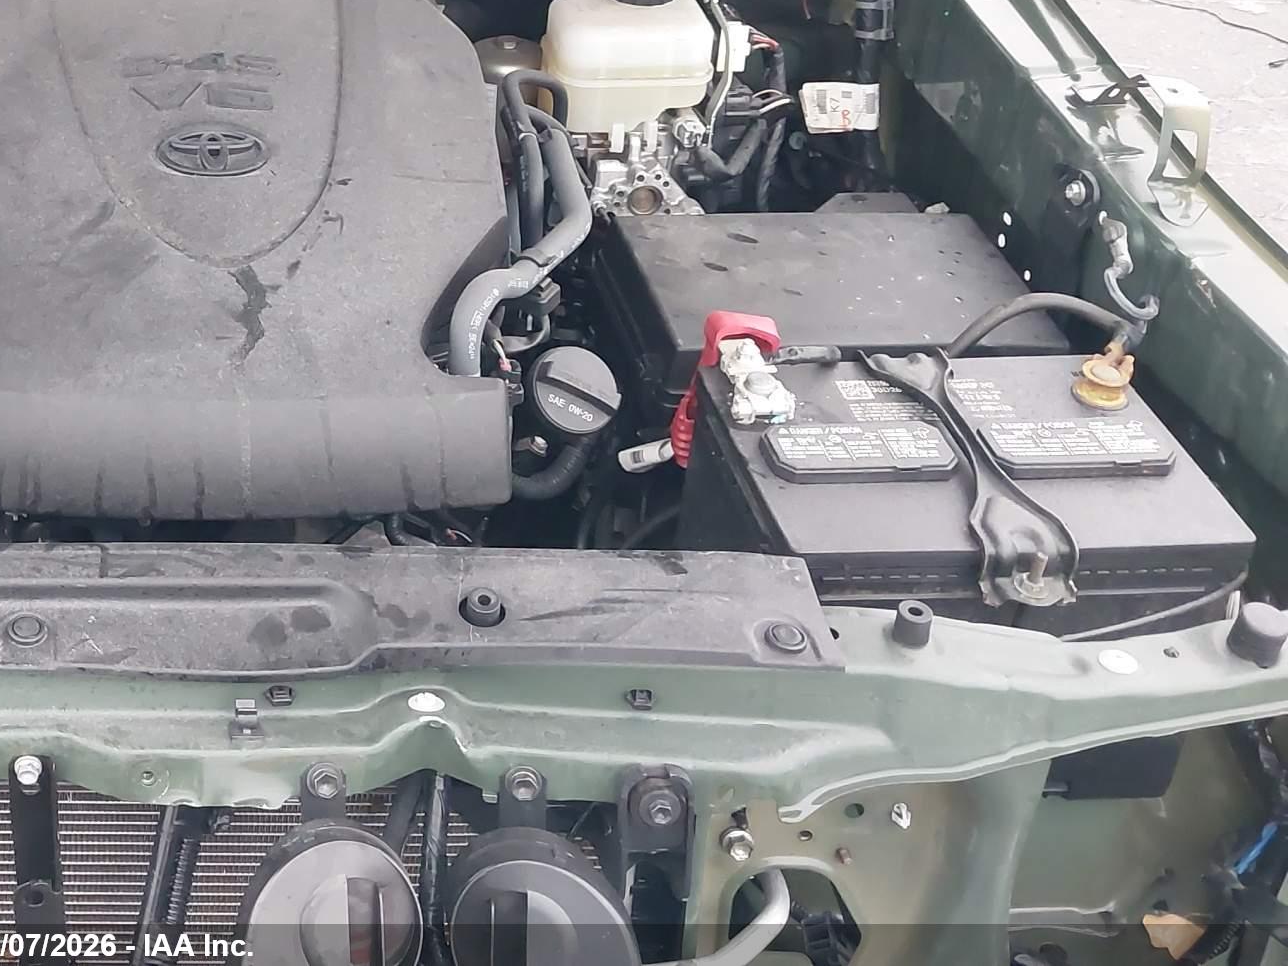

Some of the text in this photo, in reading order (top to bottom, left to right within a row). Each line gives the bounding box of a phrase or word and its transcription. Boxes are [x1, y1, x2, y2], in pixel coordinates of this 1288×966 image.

[130, 81, 274, 111] V6
[547, 393, 594, 422] SAE 0W-20
